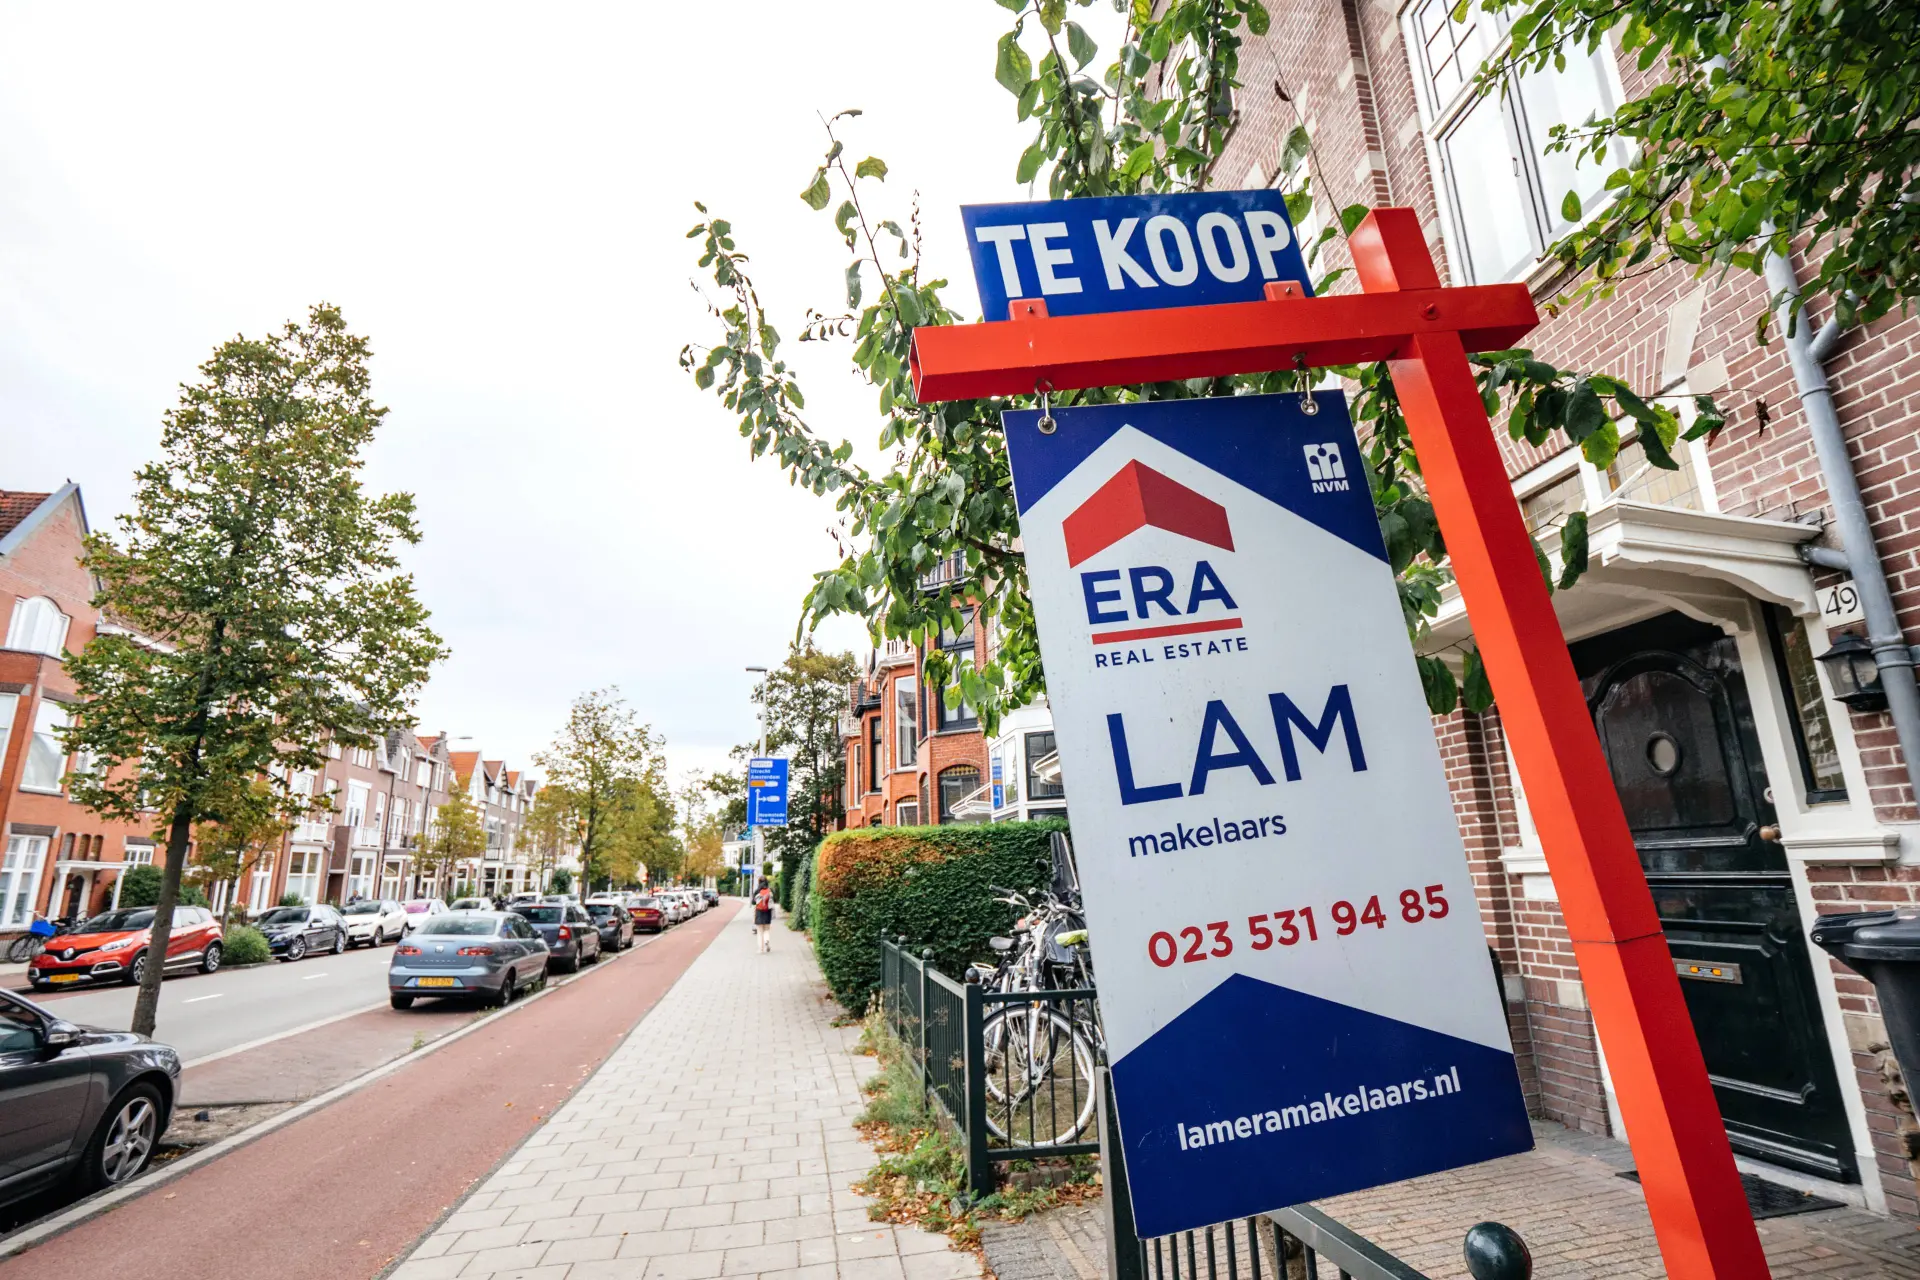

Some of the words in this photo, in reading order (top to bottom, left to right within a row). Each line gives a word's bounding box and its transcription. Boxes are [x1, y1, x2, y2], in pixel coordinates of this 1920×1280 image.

[975, 221, 1083, 298] TE
[1092, 210, 1291, 291] KOOP
[1312, 479, 1350, 494] NVM
[1080, 560, 1239, 625] ERA
[1825, 586, 1858, 615] 49
[1095, 648, 1154, 668] REAL
[1164, 637, 1249, 660] ESTATE
[1106, 684, 1368, 806] LAM
[1128, 814, 1287, 858] makelaars
[1148, 921, 1234, 968] 023
[1248, 906, 1318, 951] 531
[1331, 895, 1387, 936] 94
[1399, 884, 1449, 924] 85
[1177, 1066, 1461, 1151] lameramakelaars.nl
